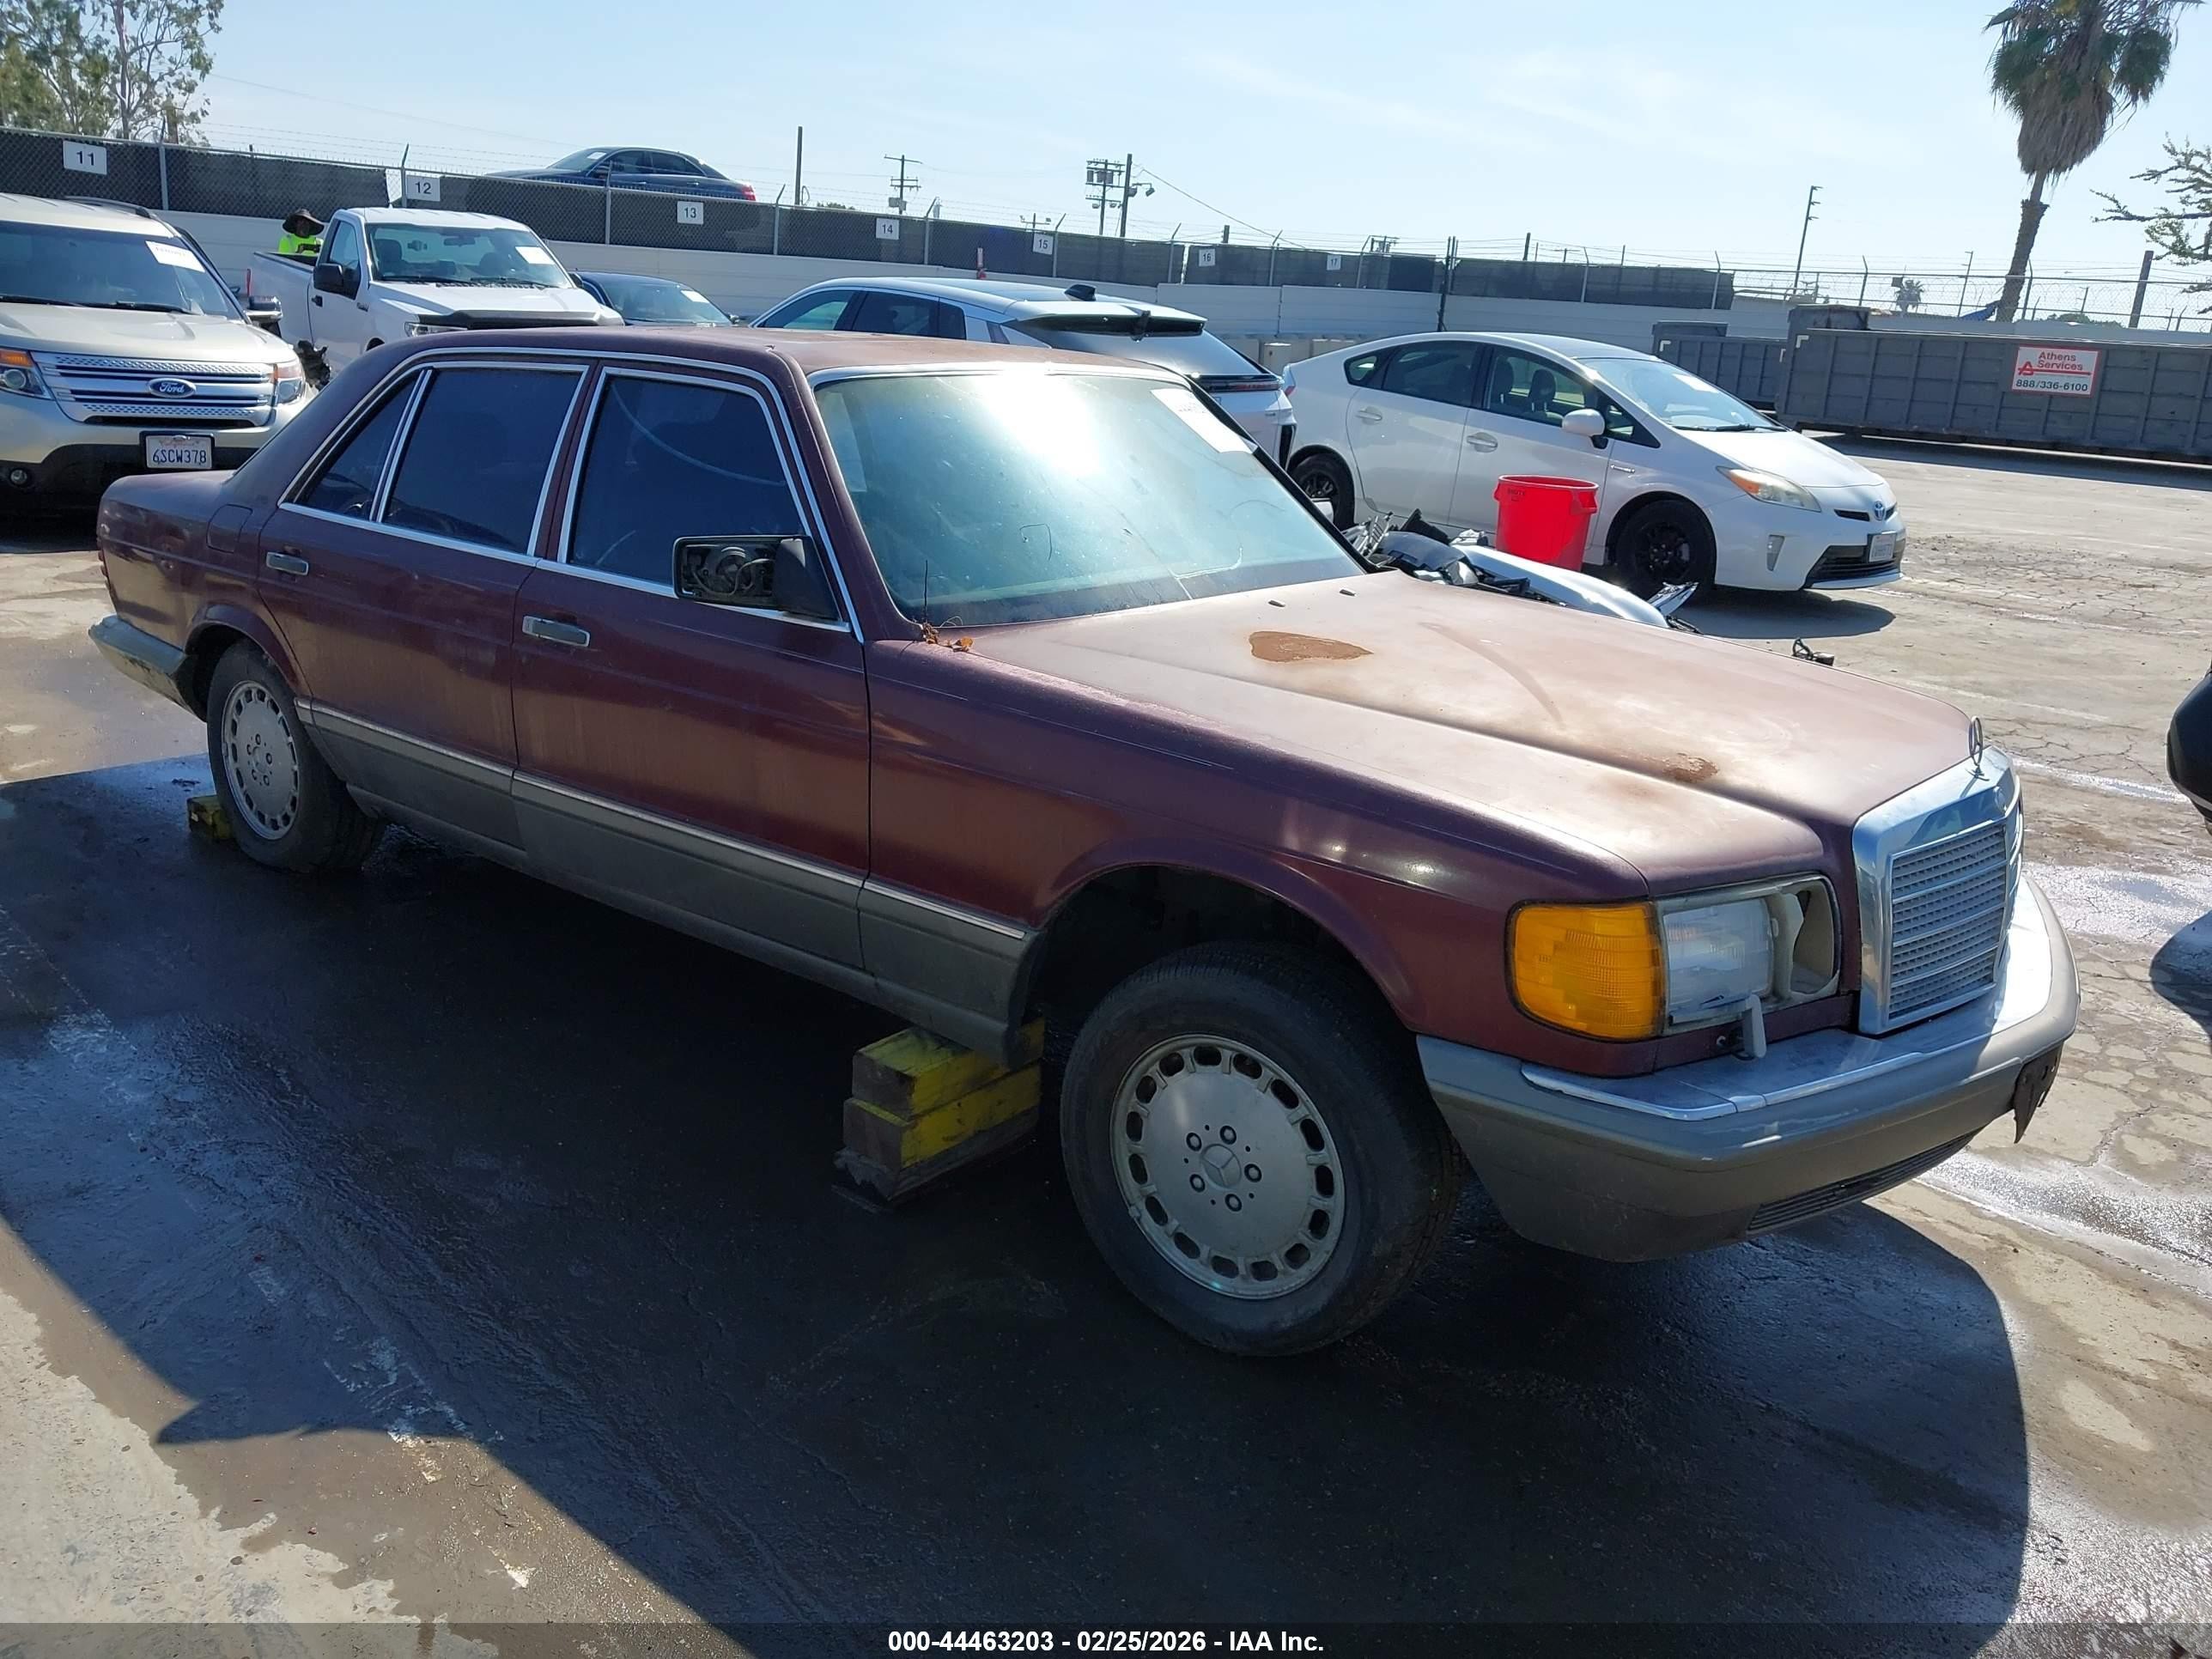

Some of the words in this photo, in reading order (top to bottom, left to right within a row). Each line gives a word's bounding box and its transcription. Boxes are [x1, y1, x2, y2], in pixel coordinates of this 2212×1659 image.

[76, 150, 94, 165] 11
[415, 181, 432, 194] 12
[684, 206, 697, 218] 13
[882, 223, 893, 234] 14
[1038, 238, 1048, 248] 15
[1202, 252, 1212, 261] 16
[2038, 351, 2076, 362] Athens
[2037, 360, 2083, 371] Services
[159, 382, 185, 393] Ford
[2015, 379, 2088, 392] 888/336-6100
[152, 448, 207, 464] 6SCW378
